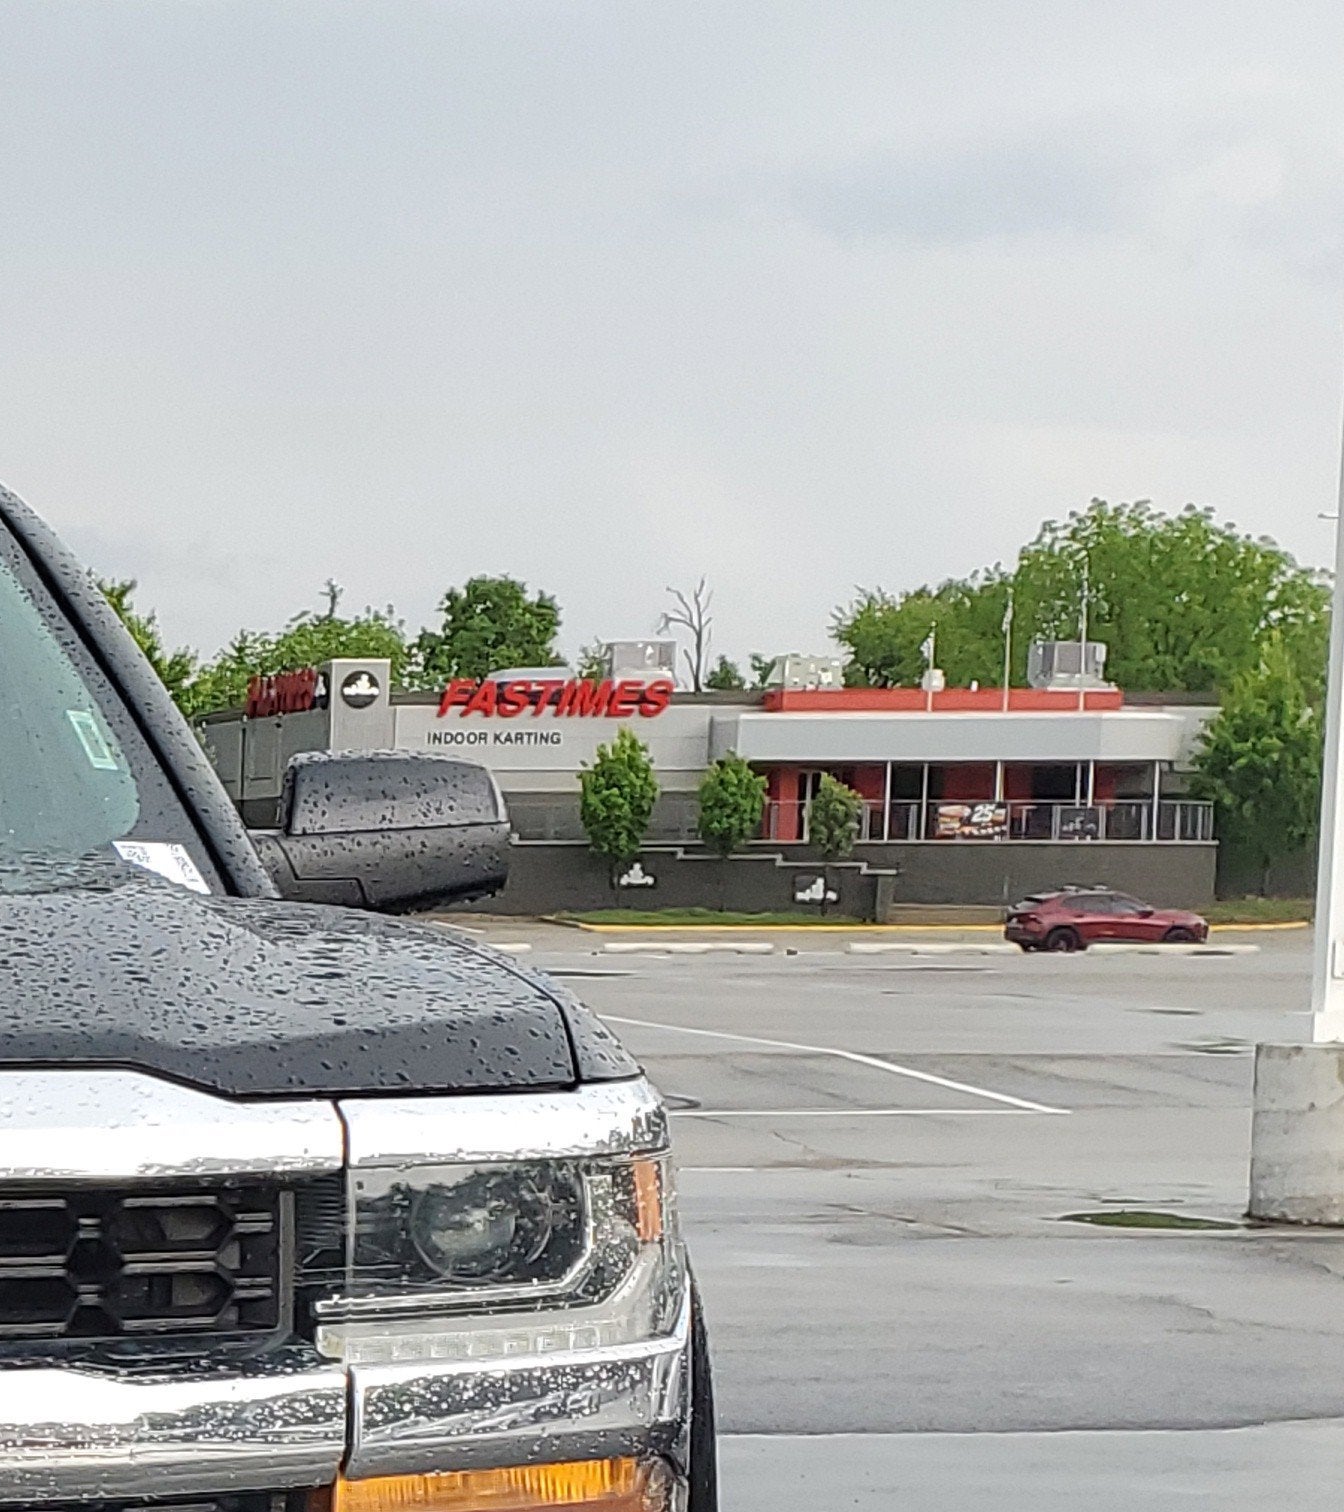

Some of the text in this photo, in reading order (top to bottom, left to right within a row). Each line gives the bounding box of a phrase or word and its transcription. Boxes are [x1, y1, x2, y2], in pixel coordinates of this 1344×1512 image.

[436, 679, 675, 718] FASTIMES
[426, 731, 562, 746] INDOOR KARTING
